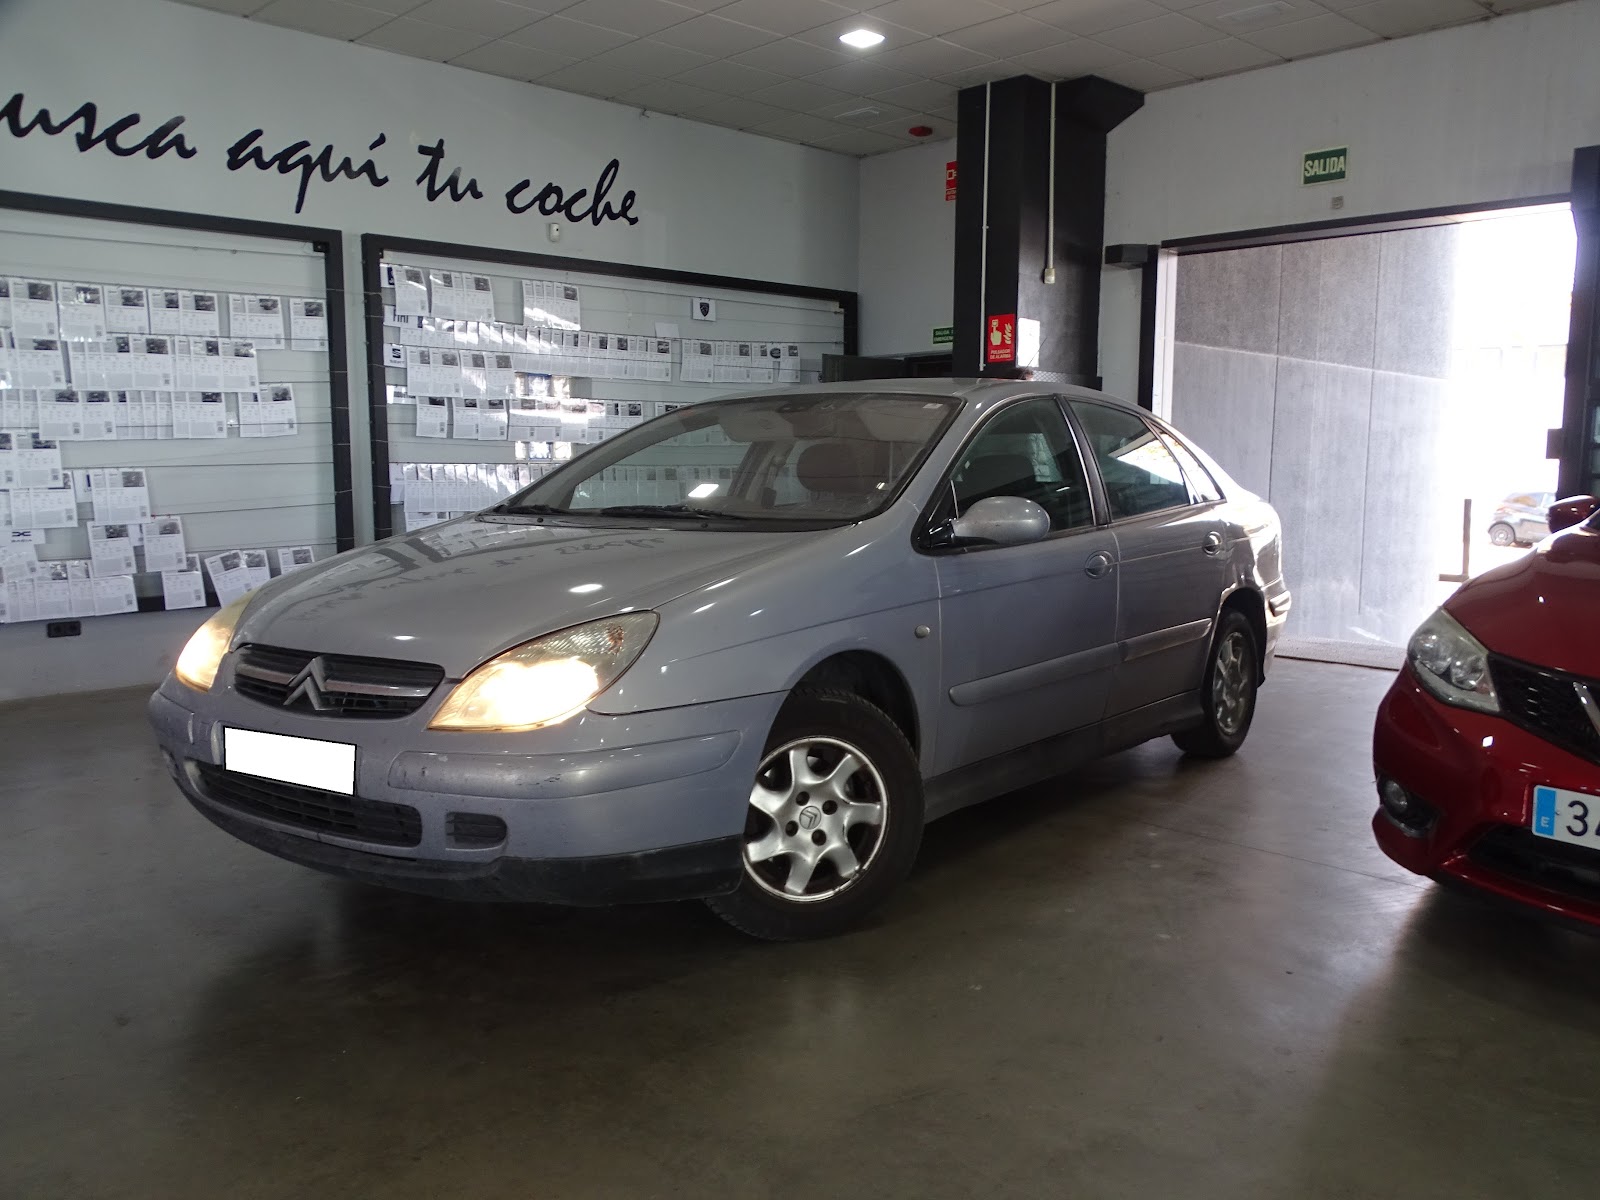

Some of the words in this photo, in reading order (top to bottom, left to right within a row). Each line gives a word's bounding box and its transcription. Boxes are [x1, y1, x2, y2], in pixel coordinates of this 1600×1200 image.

[227, 129, 390, 215] aquí
[415, 138, 484, 203] tu
[504, 158, 640, 227] coche
[1304, 156, 1345, 176] SALIDA
[1541, 816, 1550, 828] E
[1566, 800, 1600, 837] 3
